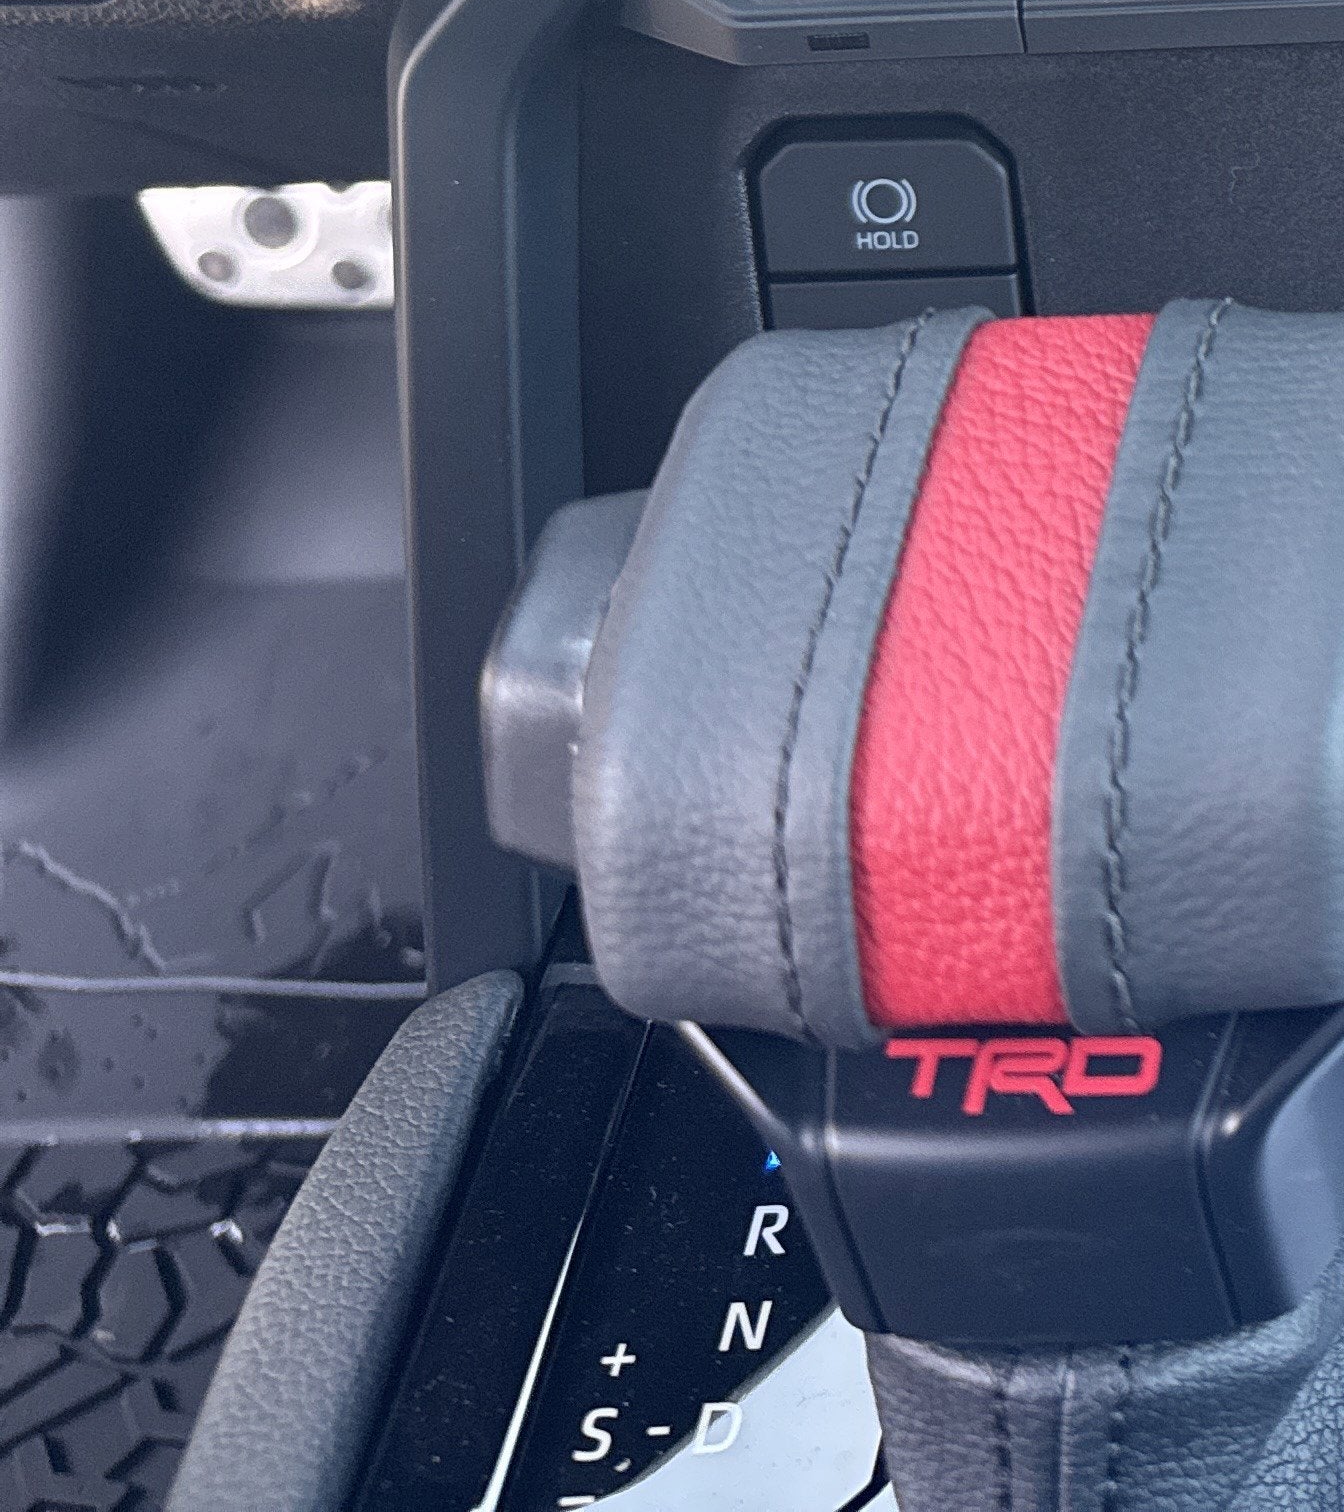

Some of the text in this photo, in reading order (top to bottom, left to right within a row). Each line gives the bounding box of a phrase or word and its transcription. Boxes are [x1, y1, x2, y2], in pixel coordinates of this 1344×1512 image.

[855, 231, 919, 249] HOLD
[884, 1035, 1162, 1116] TRD
[742, 1204, 789, 1257] R
[718, 1300, 772, 1352] N
[571, 1406, 619, 1463] S
[693, 1401, 743, 1456] D
